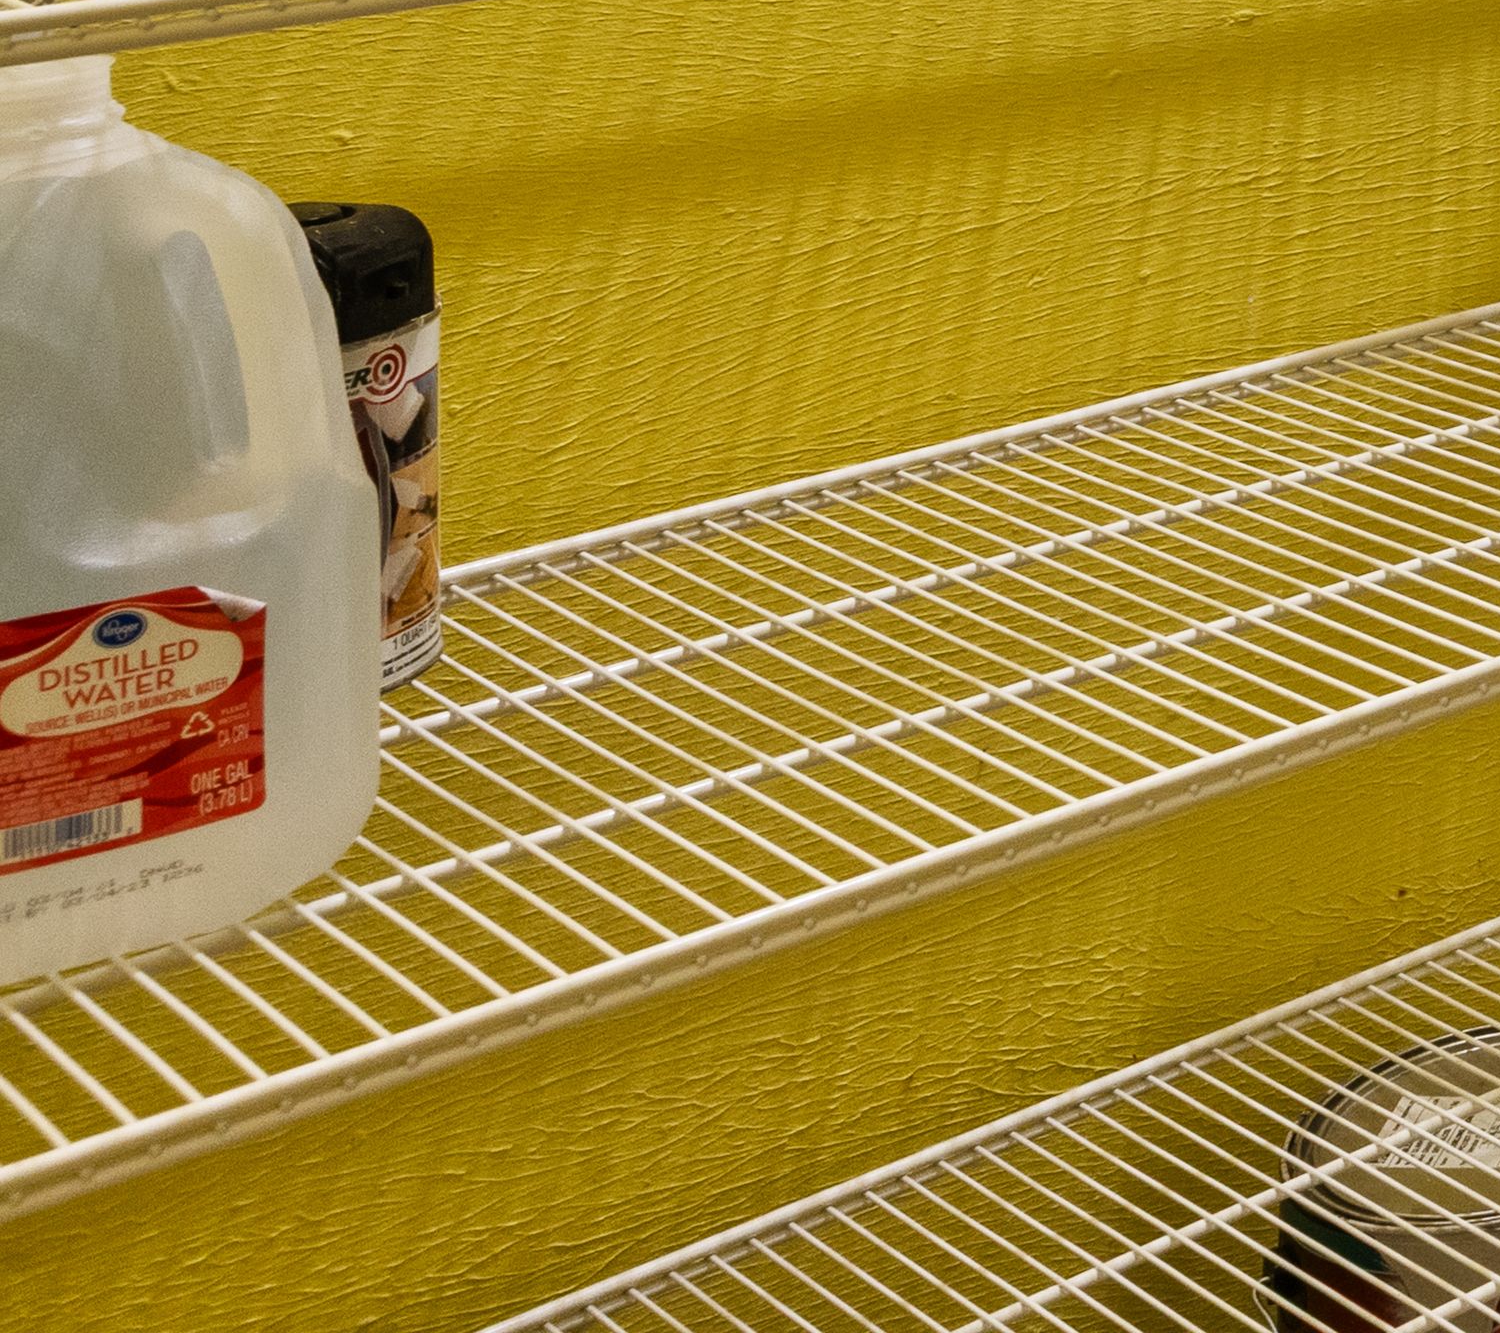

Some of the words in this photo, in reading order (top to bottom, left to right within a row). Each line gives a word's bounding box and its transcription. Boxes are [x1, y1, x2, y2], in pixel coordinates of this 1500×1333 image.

[103, 620, 141, 640] Kroger
[401, 622, 429, 647] QUART
[38, 638, 199, 693] DISTILLED
[62, 668, 175, 710] WATER
[138, 686, 193, 711] MUNICIPAL
[195, 676, 229, 695] WATER
[191, 770, 223, 795] ONE
[225, 759, 253, 783] GAL
[200, 787, 237, 816] (3.78
